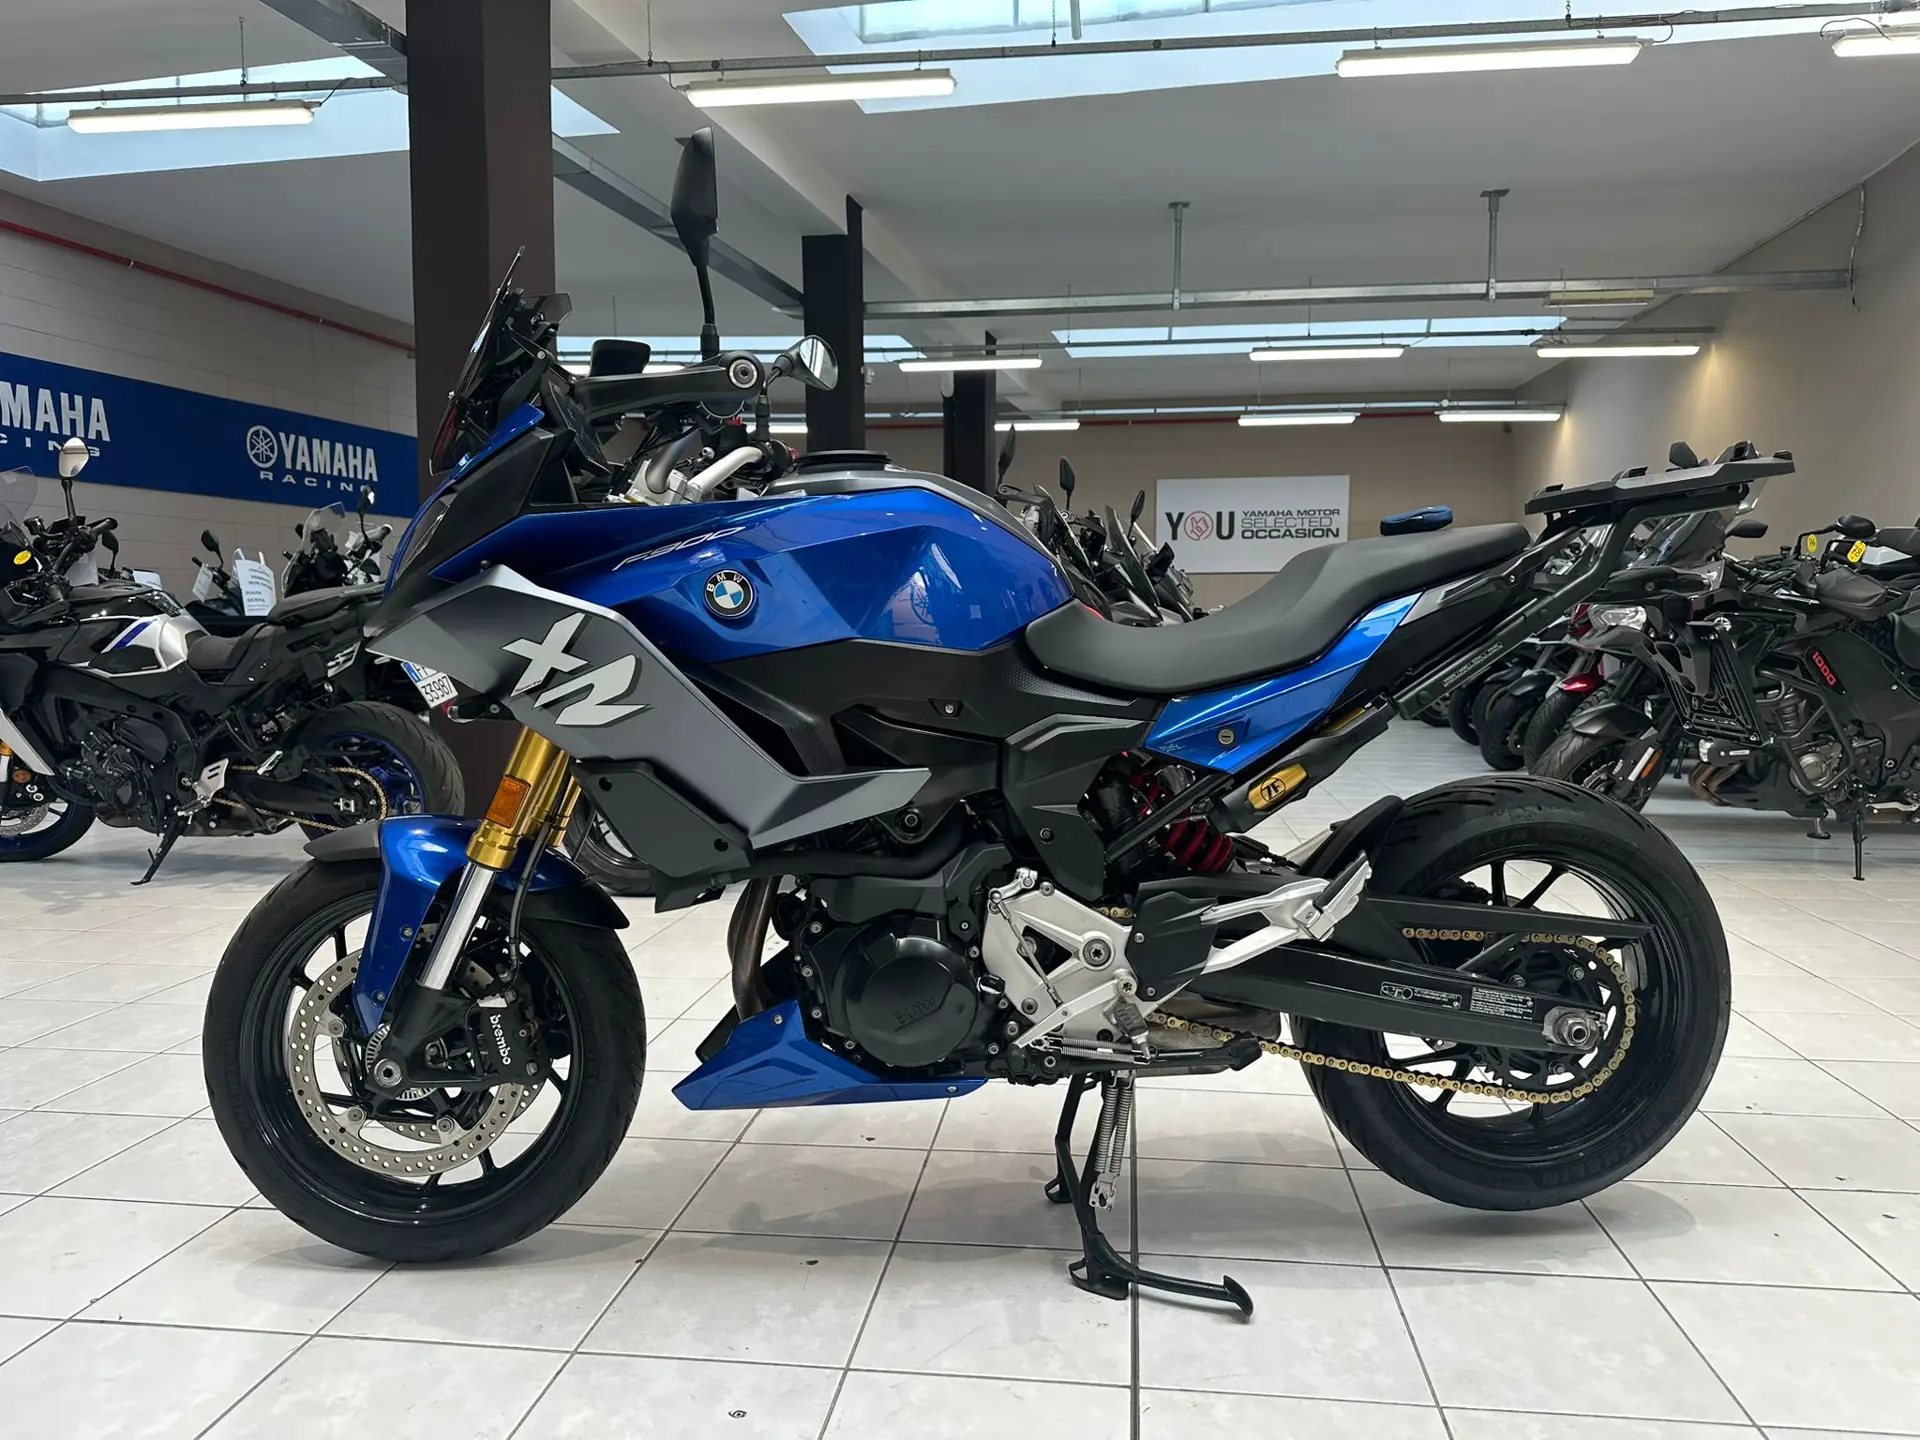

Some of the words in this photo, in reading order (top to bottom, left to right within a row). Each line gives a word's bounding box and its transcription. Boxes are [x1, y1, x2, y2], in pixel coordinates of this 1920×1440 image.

[279, 431, 378, 482] YAMAHA
[1165, 511, 1236, 541] YOU
[1241, 516, 1333, 529] SELECTED
[1242, 510, 1293, 518] YAMAHA
[1296, 509, 1341, 517] MOTOR
[1241, 528, 1340, 540] OCCASION
[706, 572, 744, 593] BMW
[1812, 651, 1837, 686] 1000
[420, 675, 453, 703] 33987
[489, 1014, 511, 1065] brembo
